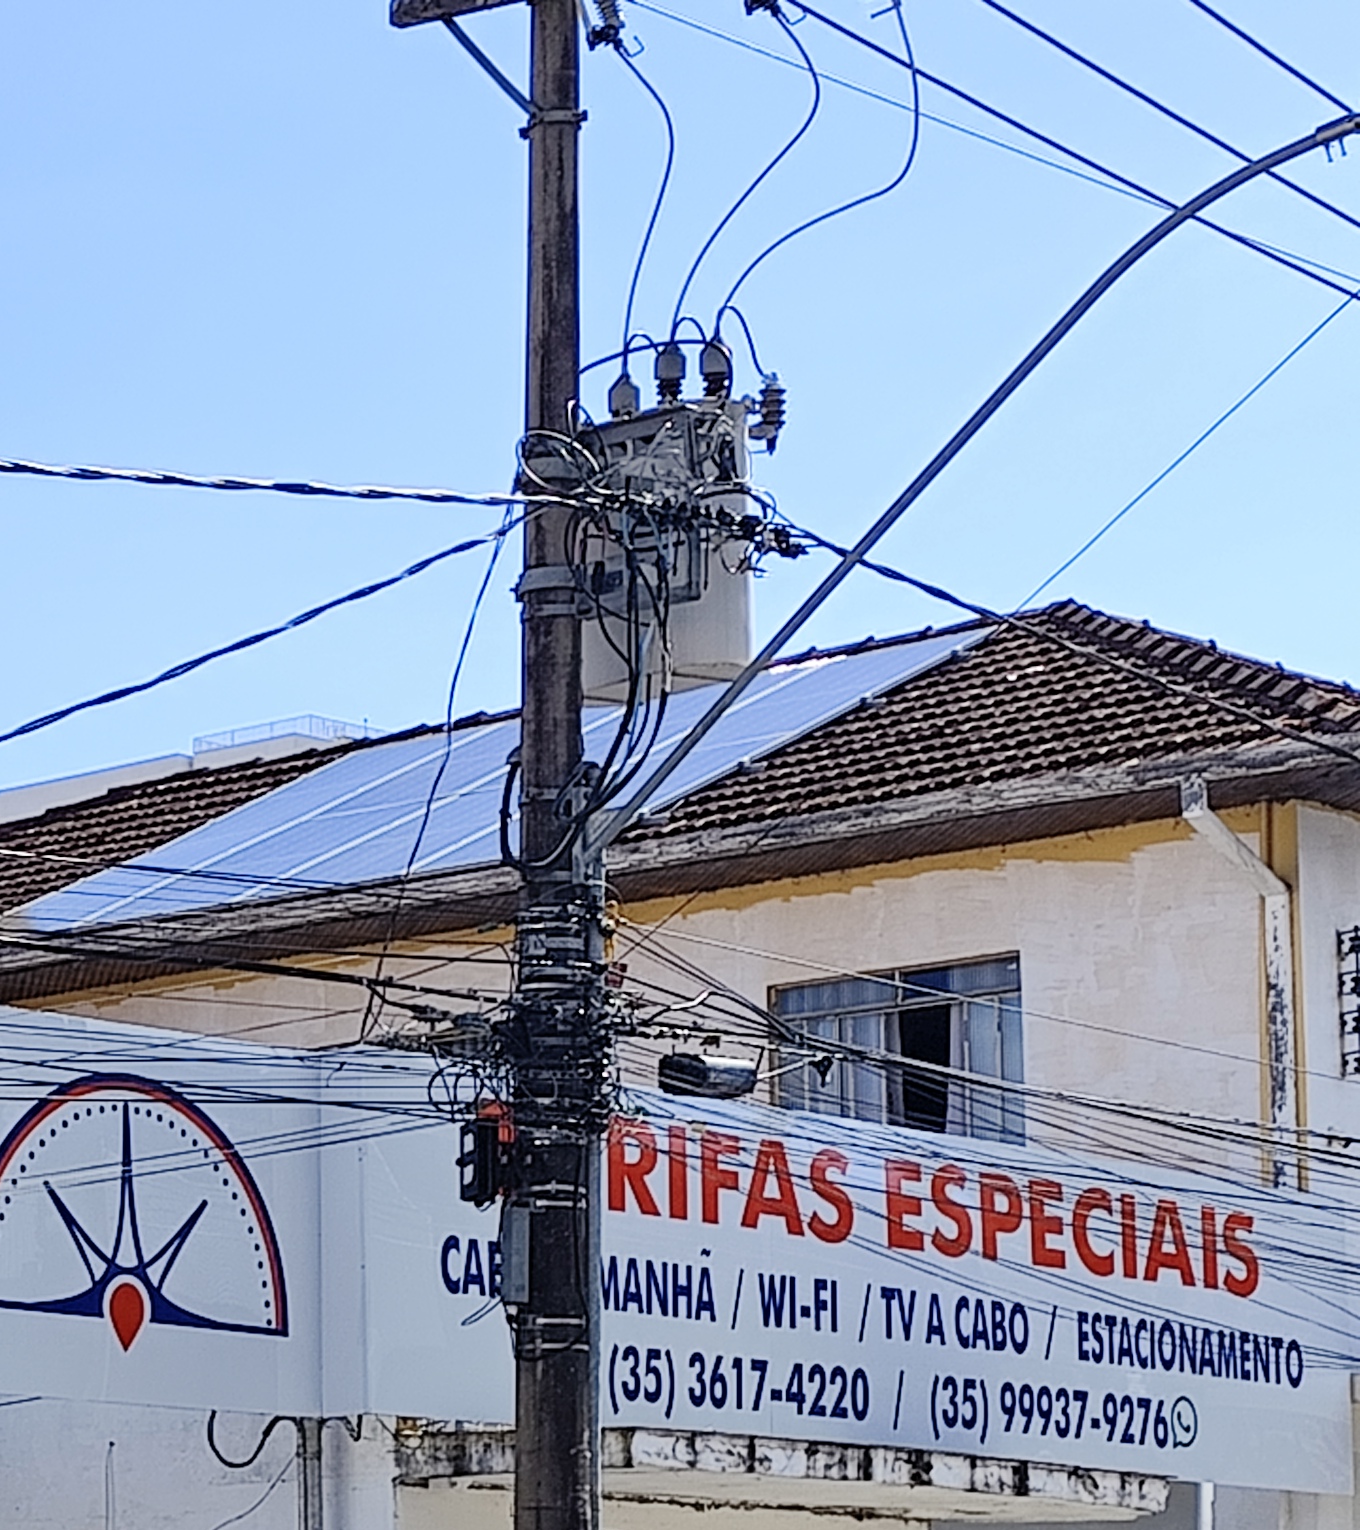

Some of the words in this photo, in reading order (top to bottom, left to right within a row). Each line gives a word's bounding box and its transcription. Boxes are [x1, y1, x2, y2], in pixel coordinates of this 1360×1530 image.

[607, 1114, 855, 1243] RIFAS
[884, 1158, 1259, 1297] ESPECIAIS
[758, 1272, 837, 1333] WI-FI
[881, 1286, 917, 1342] TV
[926, 1293, 946, 1346] A
[954, 1297, 1029, 1355] CABO
[1078, 1311, 1304, 1389] ESTACIONAMENTO
[609, 1343, 675, 1420] (35)
[688, 1352, 869, 1422] 3617-4220
[930, 1374, 989, 1444] (35)
[1000, 1381, 1169, 1449] 99937-9276
